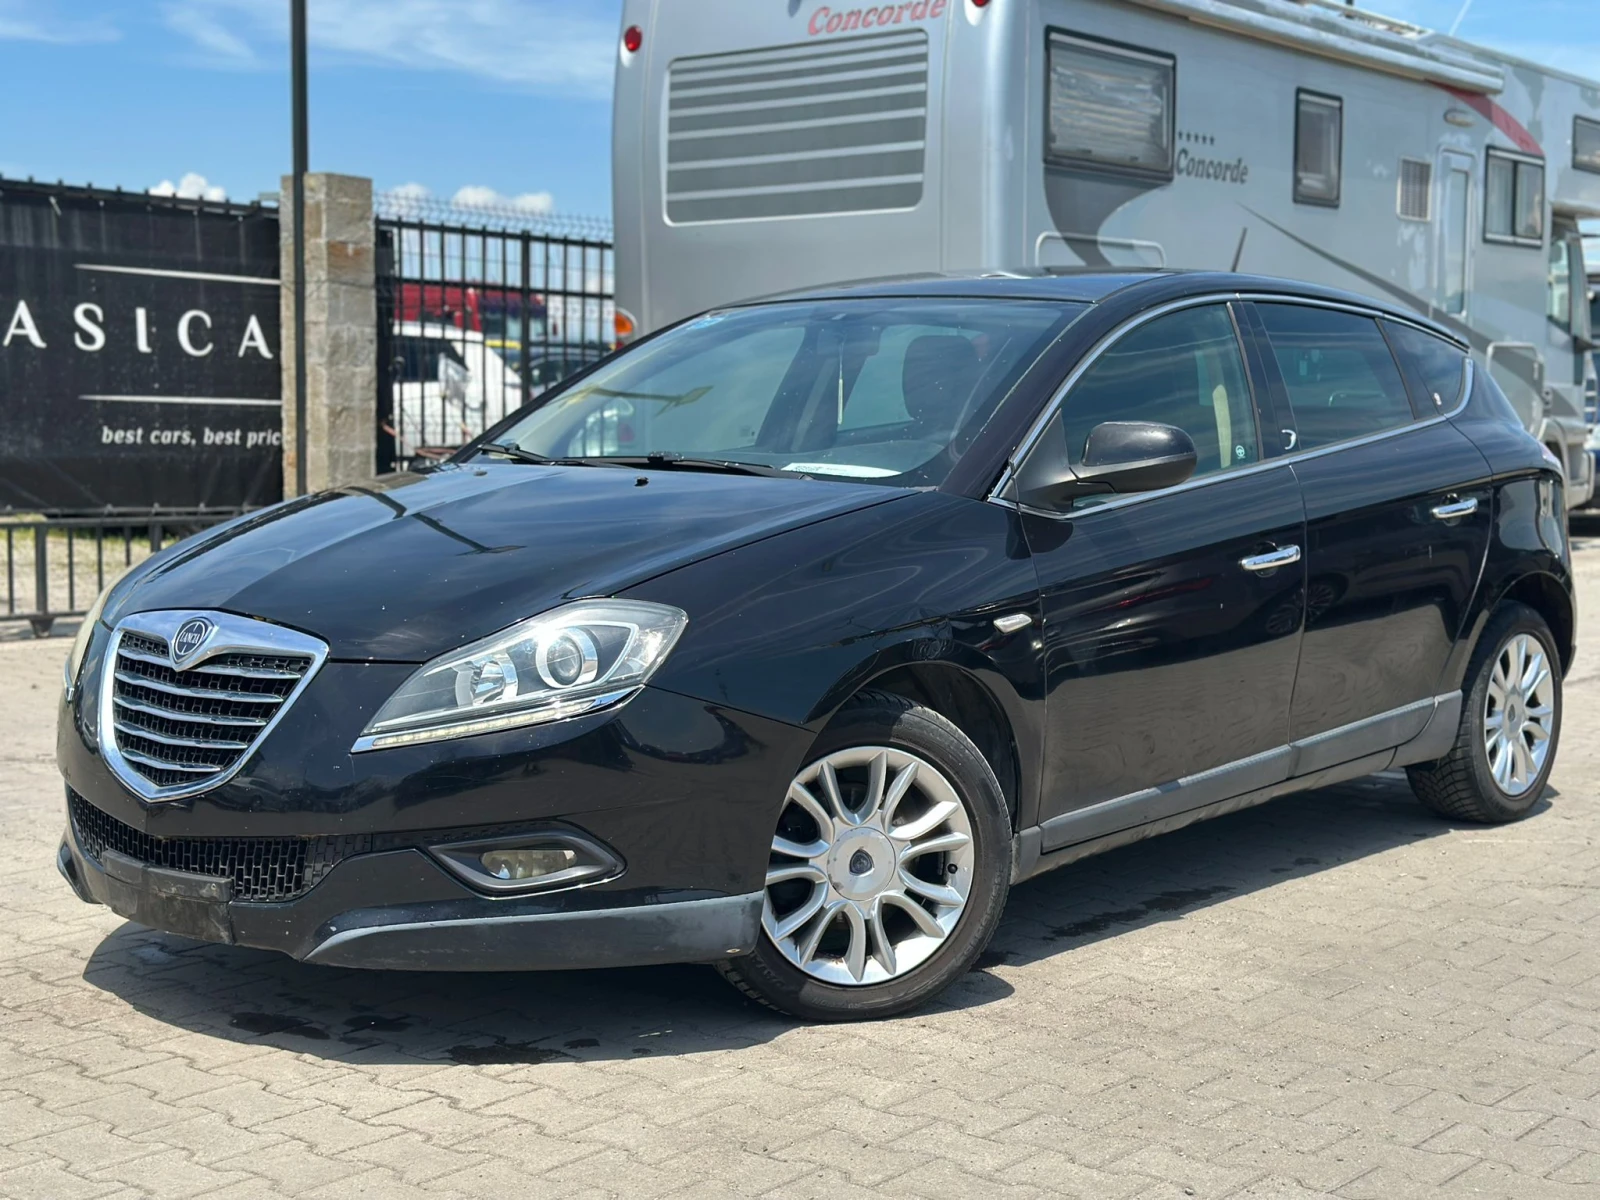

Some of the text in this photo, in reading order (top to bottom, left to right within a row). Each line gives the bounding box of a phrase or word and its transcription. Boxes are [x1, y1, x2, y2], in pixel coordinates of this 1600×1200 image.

[808, 0, 947, 36] Concorde
[1176, 147, 1248, 185] Concorde
[101, 425, 143, 444] best
[150, 428, 197, 447] cars,
[203, 427, 242, 445] best
[180, 631, 200, 644] LANCIA
